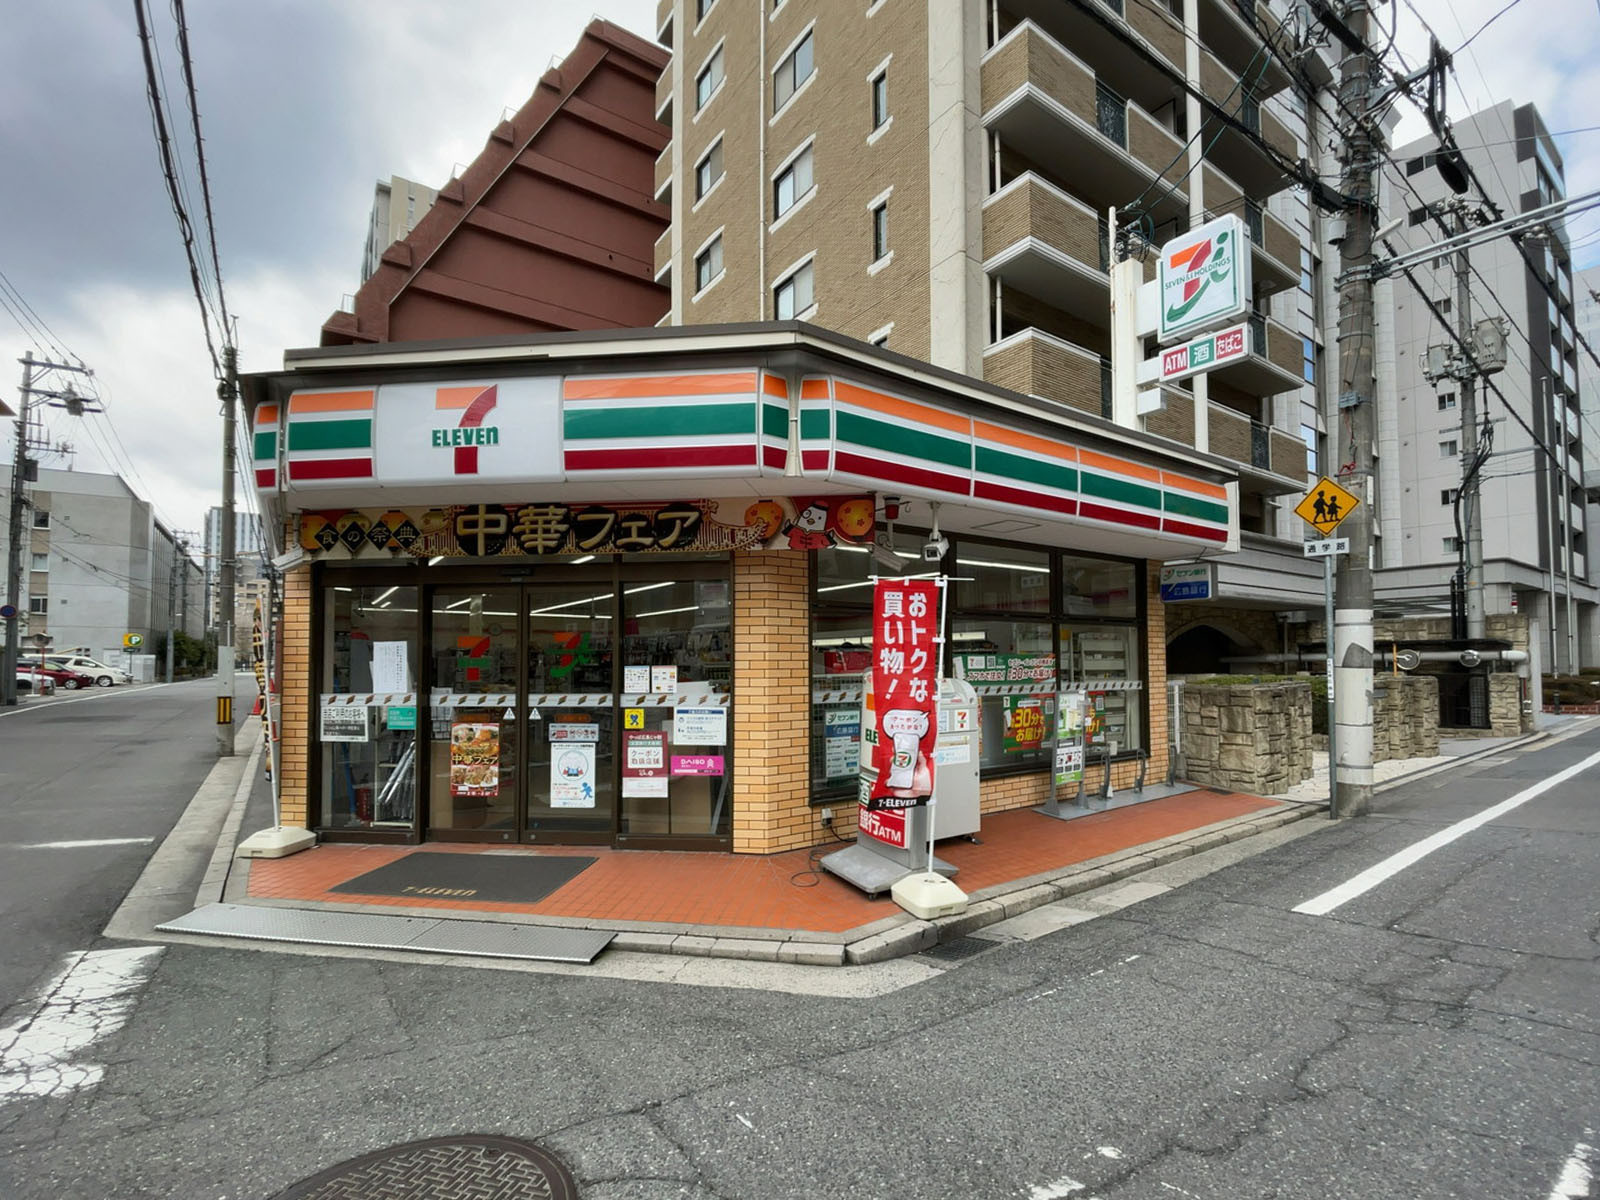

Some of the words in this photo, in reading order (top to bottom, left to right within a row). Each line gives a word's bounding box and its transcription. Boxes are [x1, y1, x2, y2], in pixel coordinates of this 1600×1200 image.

[1194, 256, 1231, 279] HOLDINGS
[1164, 350, 1188, 373] ATM
[1193, 343, 1210, 364] 酒
[1216, 333, 1243, 356] たばこ
[319, 526, 416, 545] 食の祭典
[456, 503, 701, 556] 中華フェア
[1307, 542, 1345, 553] 通学路
[1175, 568, 1207, 577] セブン銀行
[131, 636, 141, 644] P
[879, 591, 905, 700] 買い物!
[908, 592, 928, 703] おトクな
[631, 749, 660, 757] クーポン
